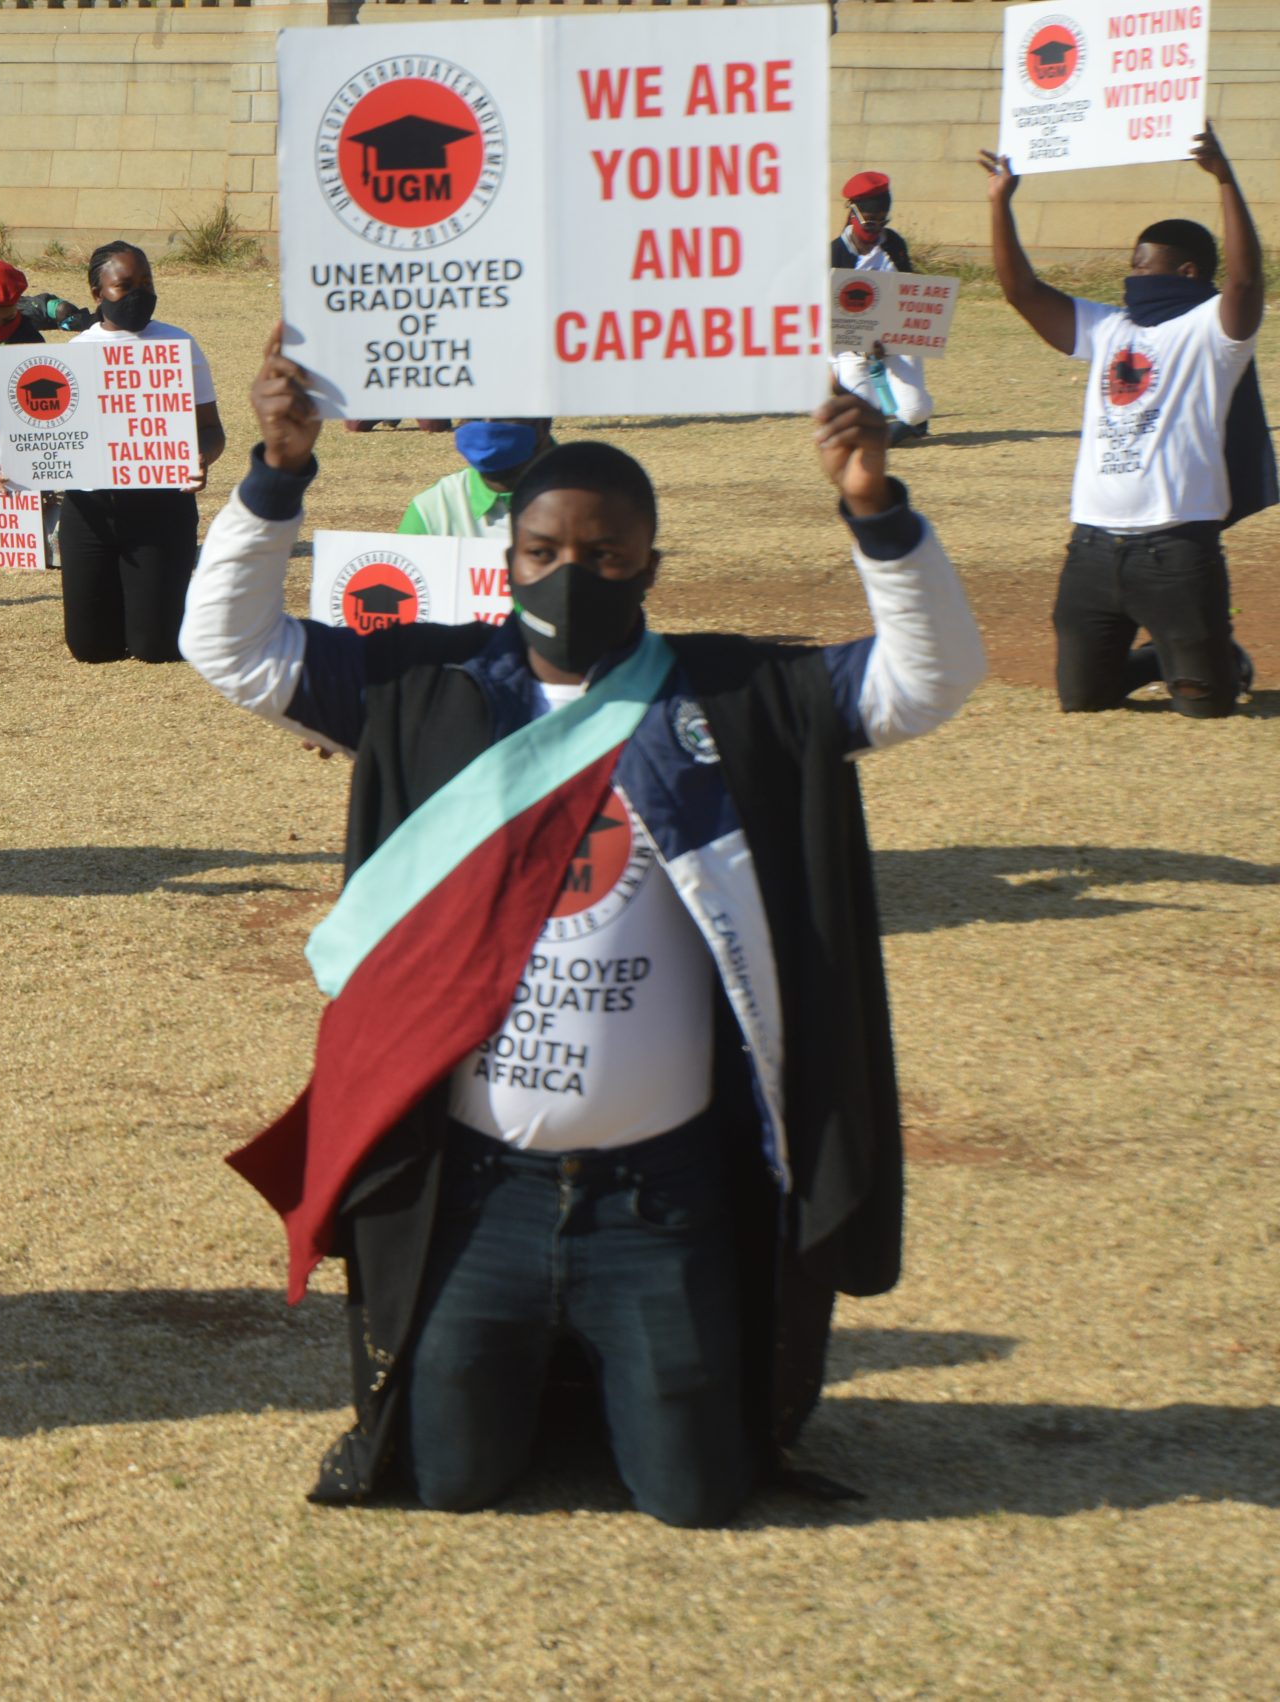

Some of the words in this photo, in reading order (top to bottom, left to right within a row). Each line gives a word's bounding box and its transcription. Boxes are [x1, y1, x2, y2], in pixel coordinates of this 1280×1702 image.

[1108, 6, 1202, 39] NOTHING
[1112, 48, 1152, 73] FOR
[1162, 43, 1195, 68] US,
[578, 66, 664, 120] WE
[683, 59, 794, 116] ARE
[1104, 77, 1201, 109] WITHOUT
[1012, 100, 1090, 117] UNEMPLOYED
[1017, 112, 1084, 128] GRADUATES
[1128, 115, 1172, 140] US!!
[320, 85, 368, 213] UNEMPLOYED
[362, 57, 471, 98] GRADUATES
[471, 97, 504, 207] MOVEMENT
[1028, 149, 1068, 160] AFRICA
[591, 142, 781, 201] YOUNG
[372, 173, 451, 202] UGM
[413, 217, 462, 248] 2018
[630, 226, 742, 280] AND
[310, 258, 525, 286] UNEMPLOYED
[325, 285, 510, 312] GRADUATES
[899, 285, 919, 296] WE
[923, 287, 950, 298] ARE
[898, 301, 944, 314] YOUNG
[398, 313, 438, 336] OF
[554, 304, 823, 363] CAPABLE!
[902, 318, 931, 330] AND
[365, 339, 471, 363] SOUTH
[881, 332, 946, 348] CAPABLE!
[103, 346, 134, 365] WE
[142, 345, 180, 364] ARE
[104, 370, 140, 389] FED
[150, 369, 183, 388] UP!
[364, 365, 475, 389] AFRICA
[30, 400, 60, 411] UGM
[98, 394, 136, 414] THE
[143, 393, 192, 412] TIME
[10, 431, 88, 443] UNEMPLOYED
[128, 418, 167, 437] FOR
[16, 441, 84, 452] GRADUATES
[43, 452, 58, 460] OF
[108, 441, 190, 461] TALKING
[32, 461, 71, 471] SOUTH
[32, 470, 73, 480] AFRICA
[112, 466, 130, 485] IS
[138, 465, 190, 485] OVER
[0, 494, 39, 511] TIME
[528, 953, 652, 984] PLOYED
[515, 981, 636, 1013] DUATES
[513, 1010, 557, 1035] OF
[474, 1057, 583, 1095] AFRICA
